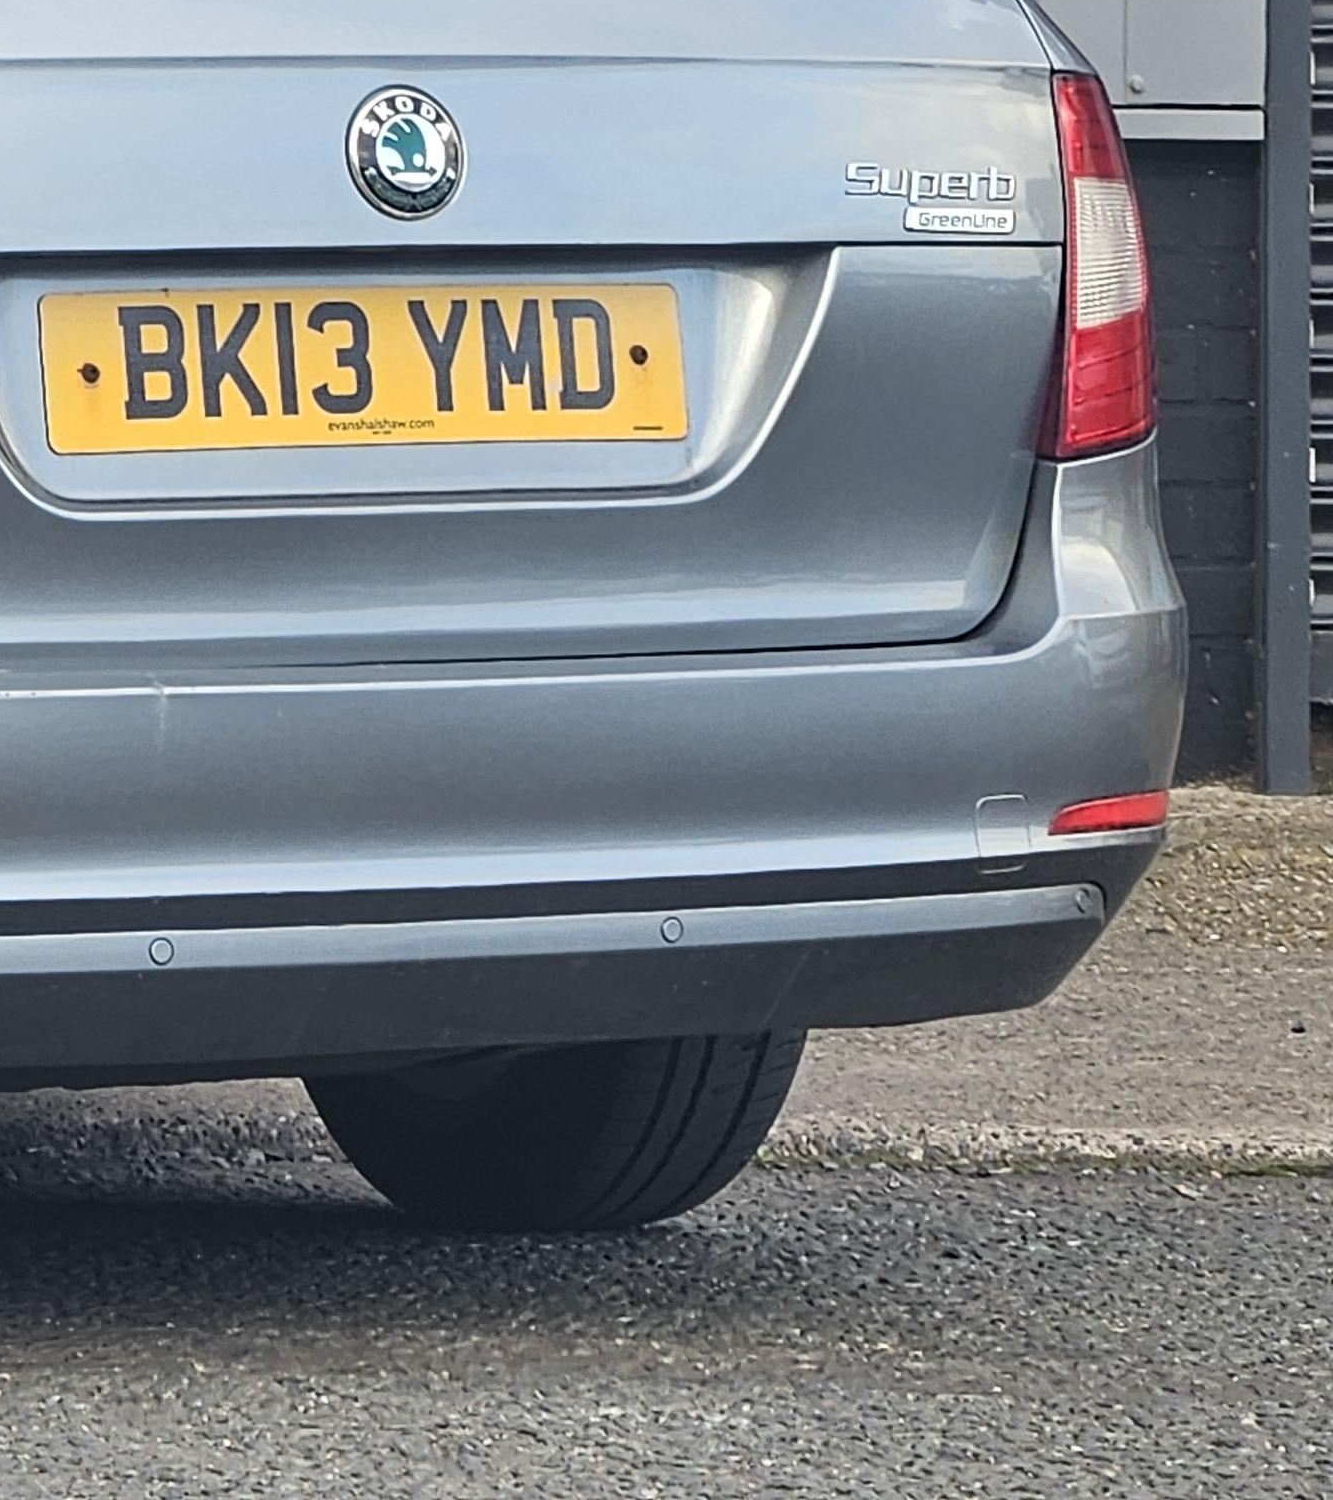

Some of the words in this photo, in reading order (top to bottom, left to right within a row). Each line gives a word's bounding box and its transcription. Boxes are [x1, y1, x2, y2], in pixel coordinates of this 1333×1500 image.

[845, 162, 1016, 206] Superb
[117, 301, 374, 420] BK13
[408, 298, 616, 413] YMD
[327, 417, 436, 432] evanshalshaw.com
